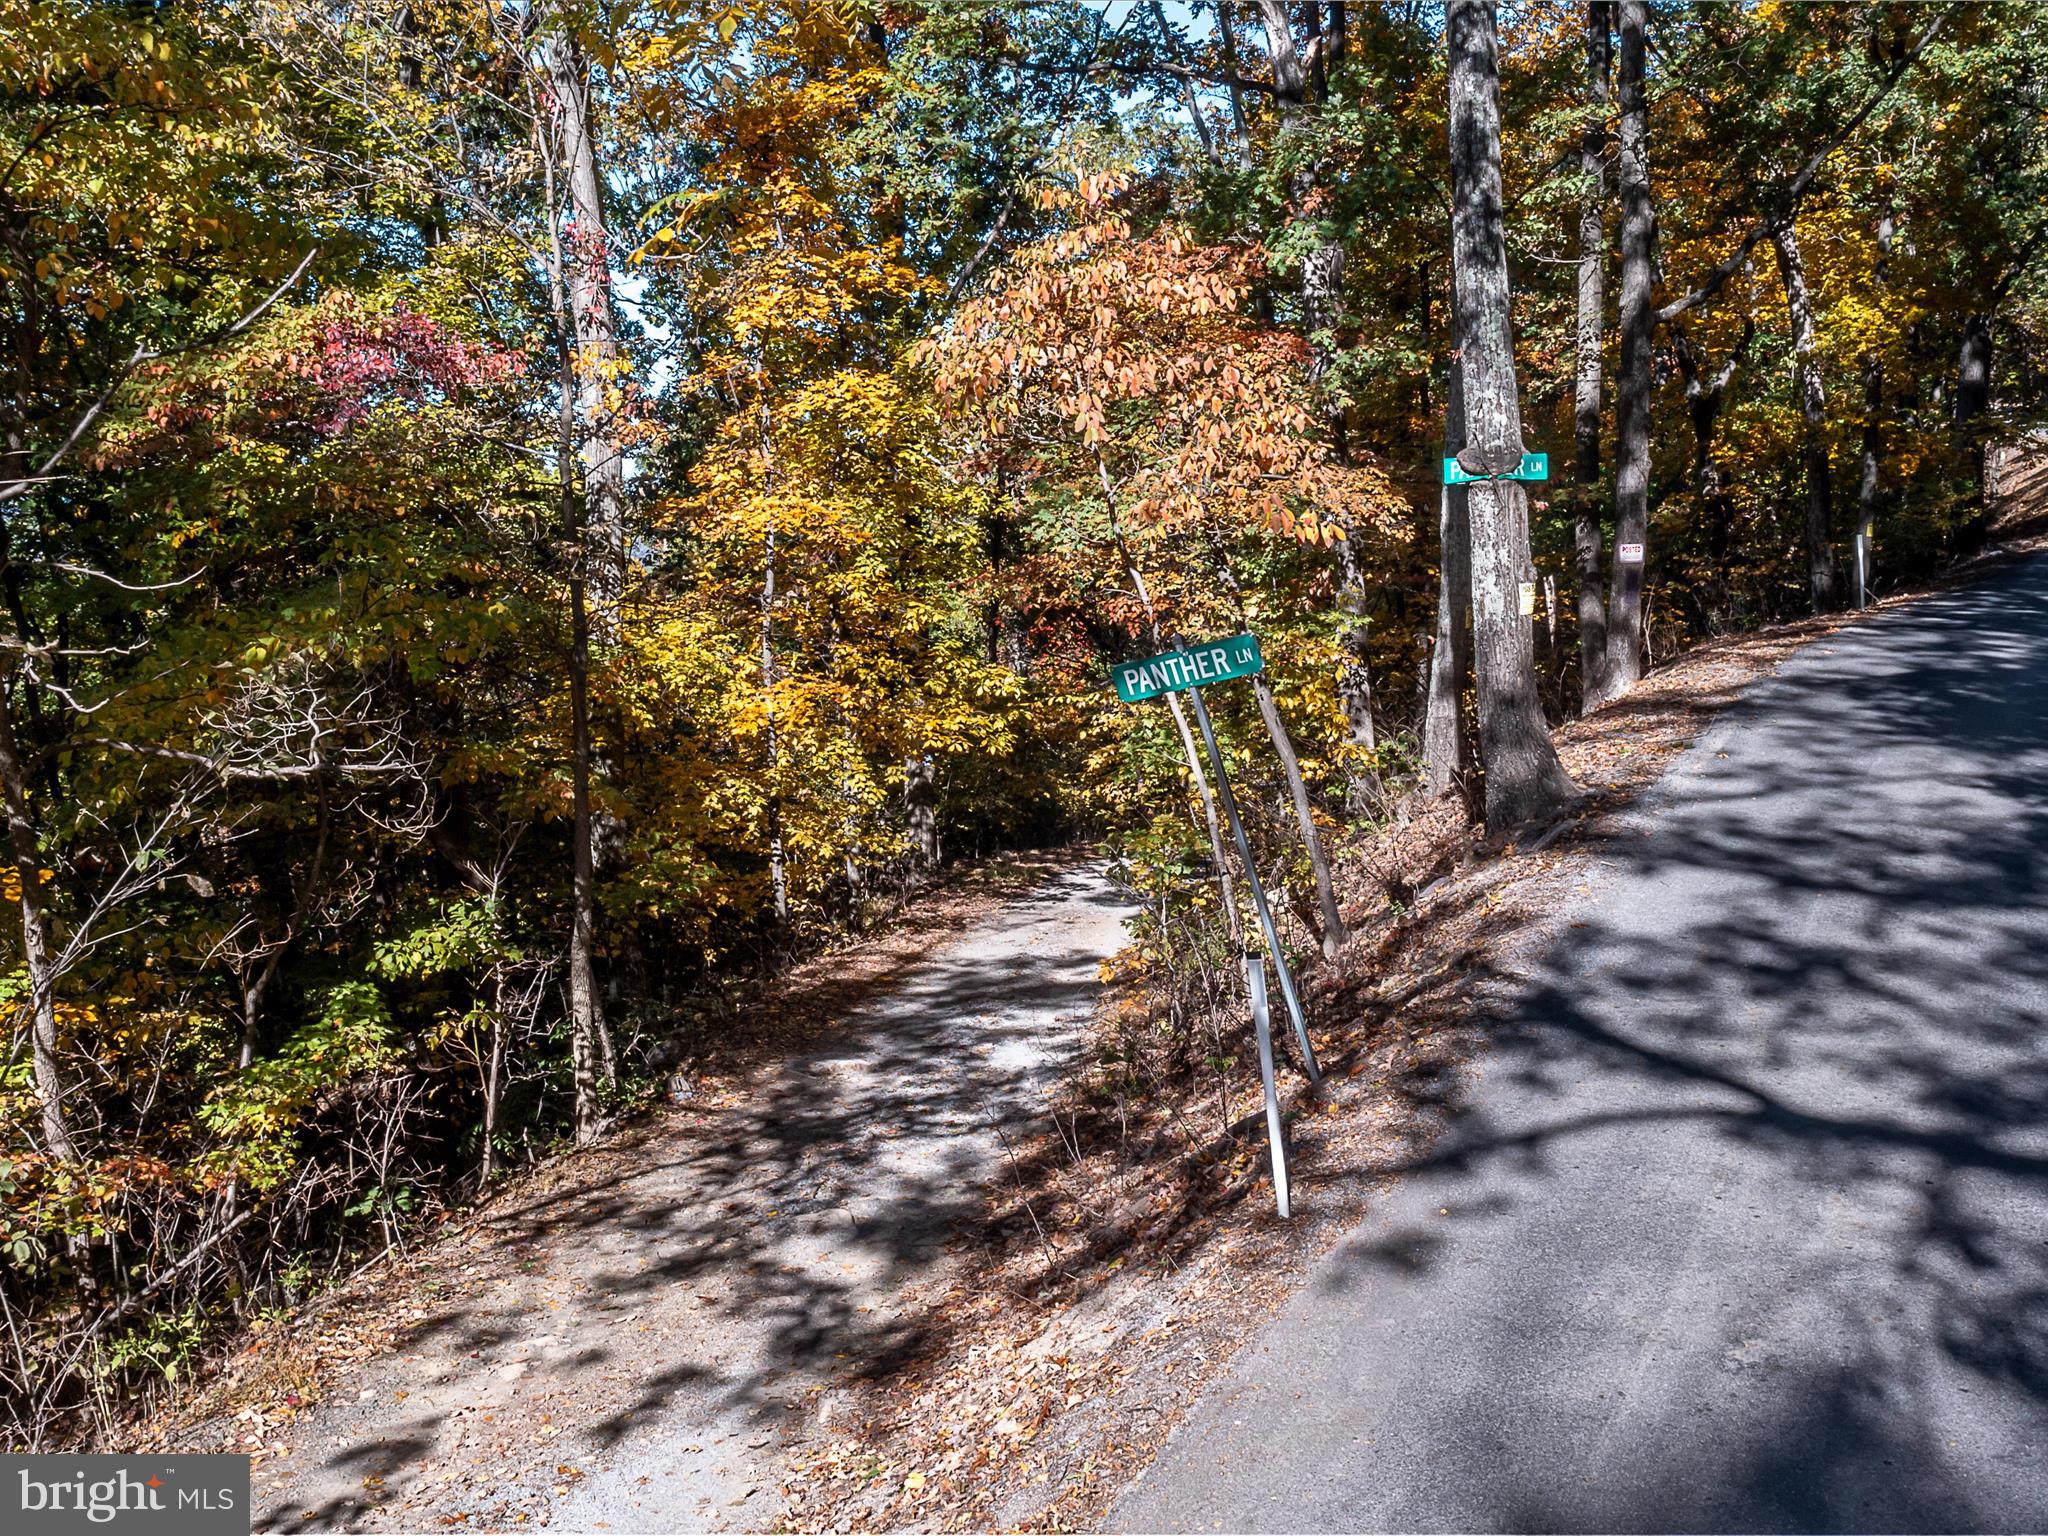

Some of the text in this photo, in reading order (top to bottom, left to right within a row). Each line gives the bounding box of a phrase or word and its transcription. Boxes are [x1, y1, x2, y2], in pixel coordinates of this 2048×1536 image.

[1530, 461, 1543, 472] LN
[1123, 647, 1253, 696] PANTHER LN
